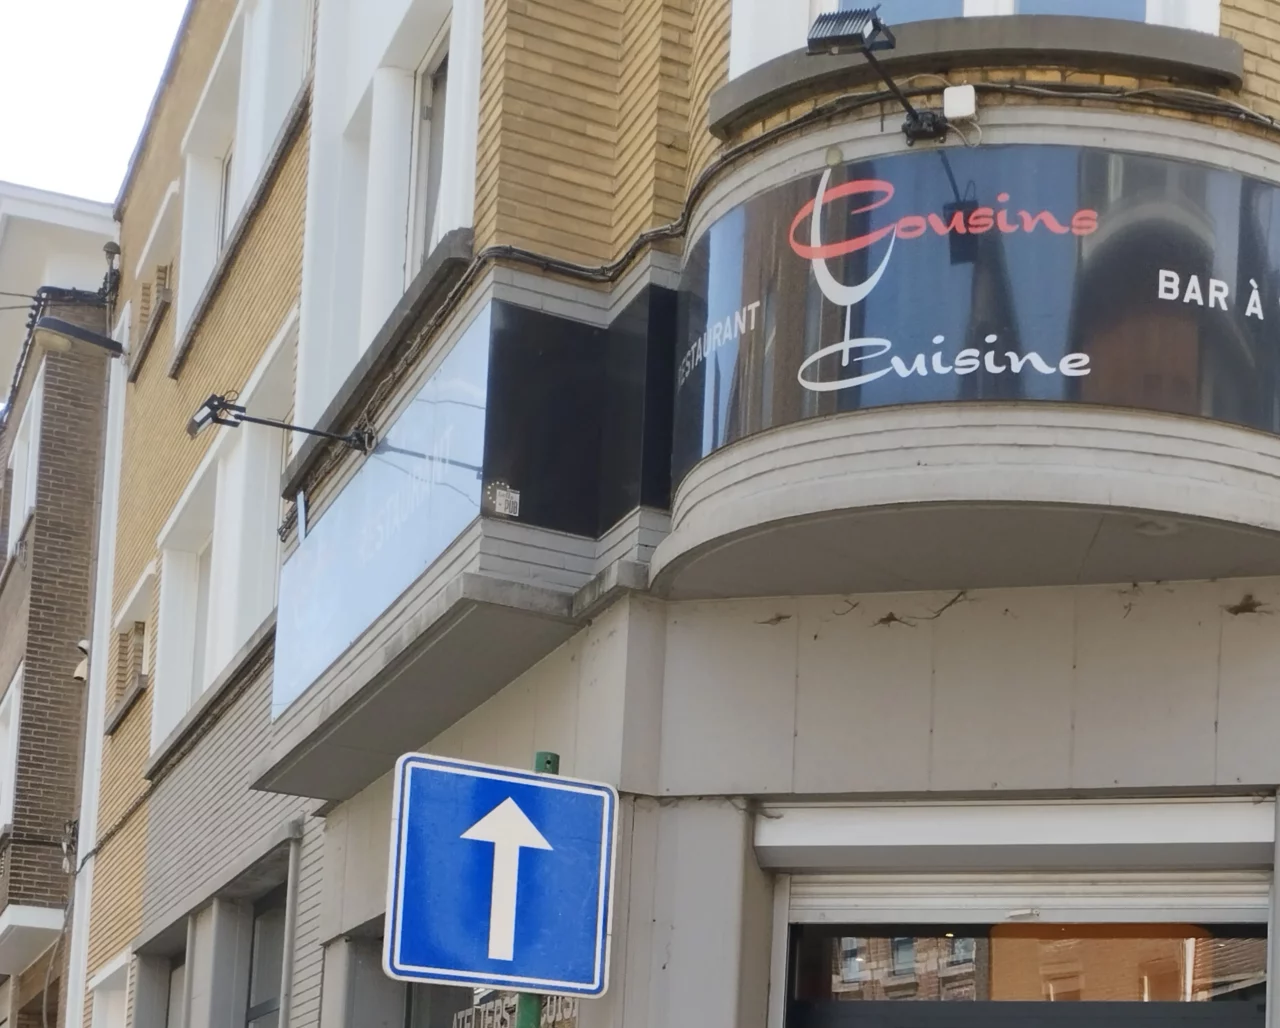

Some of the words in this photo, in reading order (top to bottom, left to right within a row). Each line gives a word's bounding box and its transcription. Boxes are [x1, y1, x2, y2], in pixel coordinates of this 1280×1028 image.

[788, 179, 1099, 260] Cousins
[1158, 268, 1230, 312] BAR
[1244, 277, 1265, 321] À
[676, 299, 761, 388] ESTAURANT
[797, 334, 1092, 392] Cuisine
[541, 995, 579, 1026] UIS
